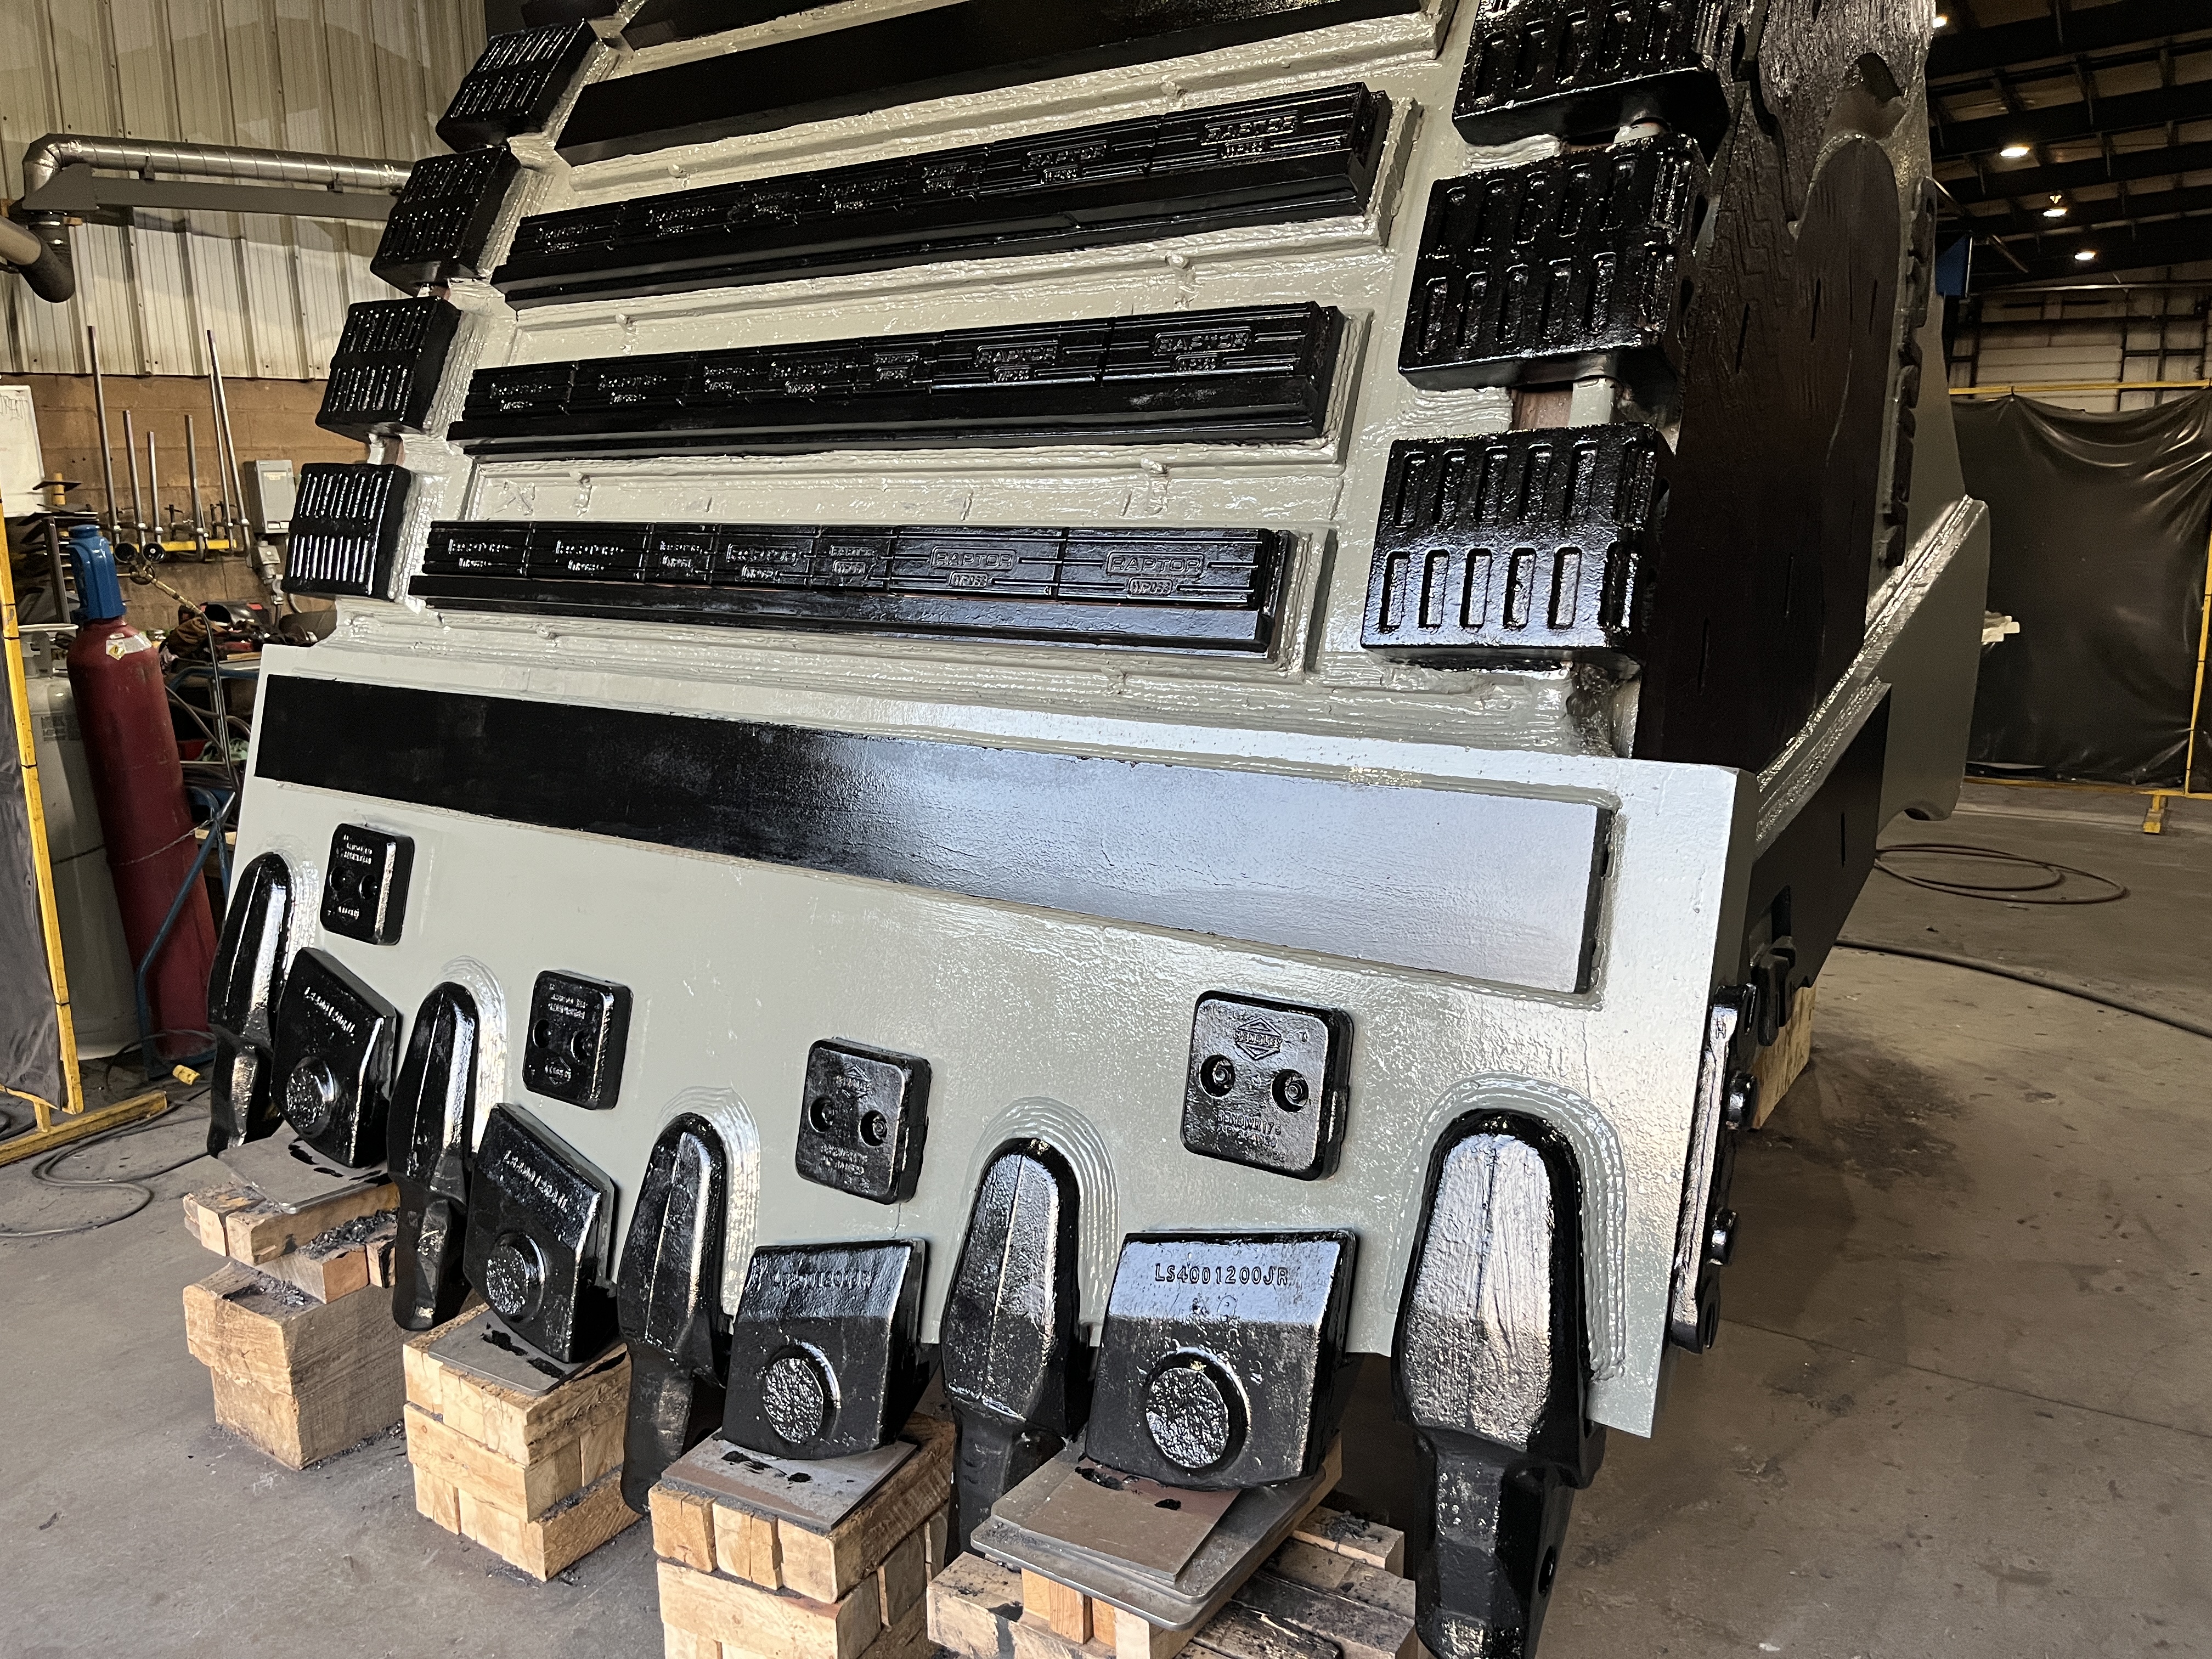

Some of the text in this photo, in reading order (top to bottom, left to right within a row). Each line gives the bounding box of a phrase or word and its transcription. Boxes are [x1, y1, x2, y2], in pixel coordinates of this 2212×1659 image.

[1206, 115, 1297, 140] RAPTOR
[1157, 332, 1249, 352] RAPTOR
[979, 346, 1057, 364] RAPTOR
[935, 551, 1013, 567] RAPTOR
[1110, 555, 1201, 573] RAPTOR
[1233, 1030, 1283, 1047] HENSLEY
[1155, 1262, 1288, 1286] LS4001200JR
